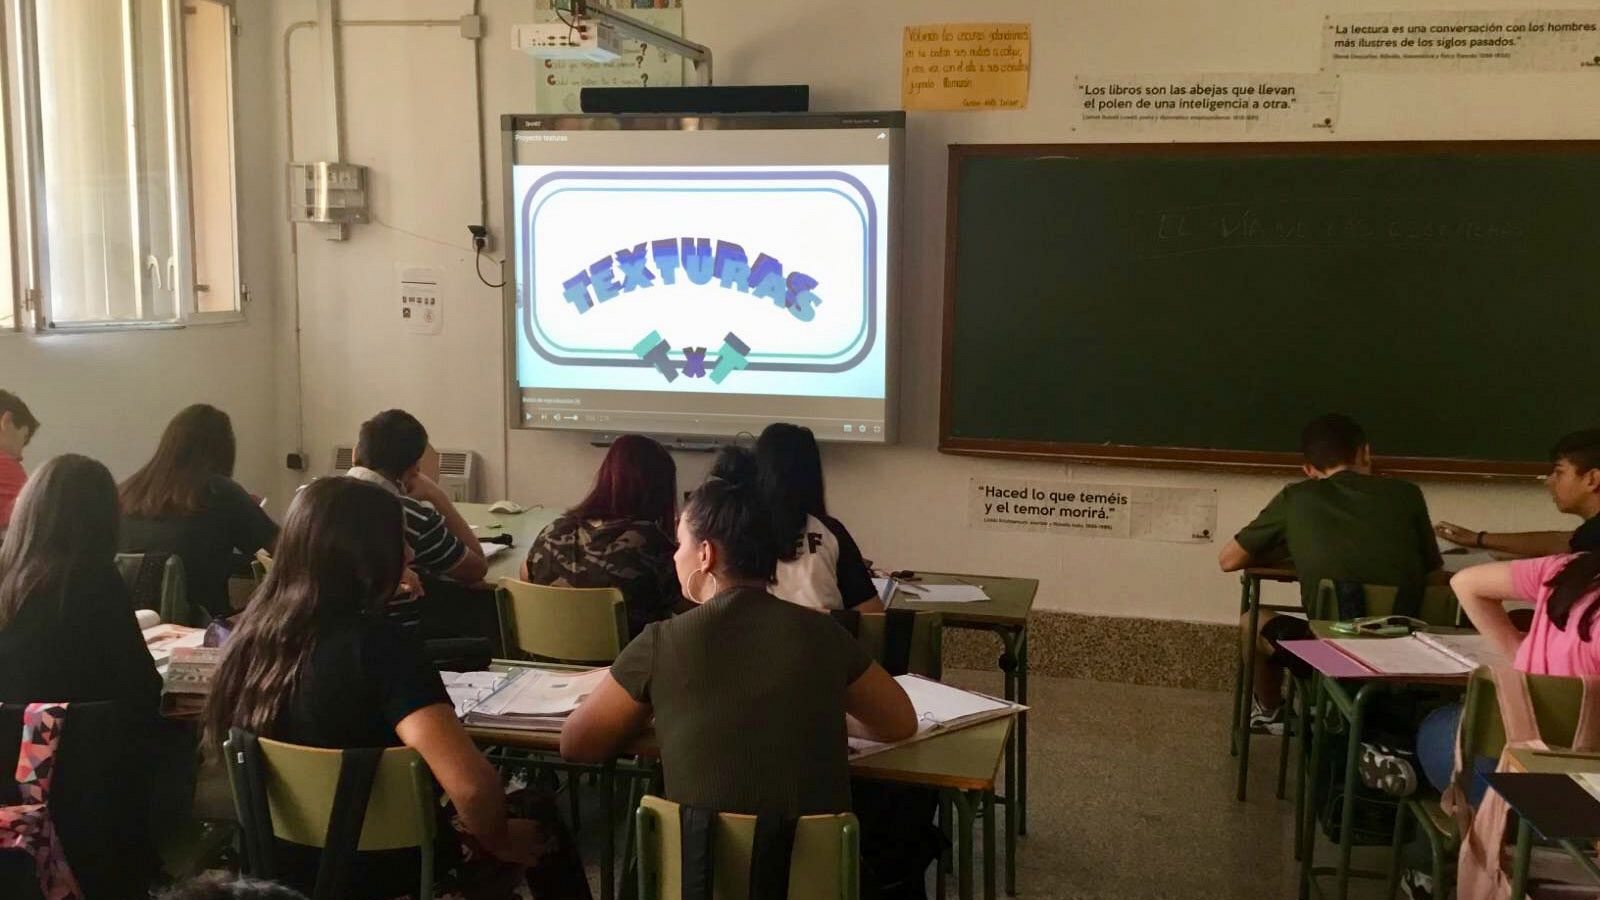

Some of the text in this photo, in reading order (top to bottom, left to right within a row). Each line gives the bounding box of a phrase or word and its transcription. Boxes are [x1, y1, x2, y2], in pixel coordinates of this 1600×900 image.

[1351, 24, 1389, 34] lectura
[1392, 26, 1405, 34] es
[1407, 25, 1427, 33] una
[1430, 22, 1501, 33] conversación
[1506, 24, 1526, 32] con
[1528, 22, 1545, 32] los
[1548, 22, 1597, 32] hombres
[1334, 37, 1355, 48] más
[1359, 37, 1397, 47] ilustres
[1401, 37, 1415, 47] de
[1418, 37, 1433, 47] los
[1437, 37, 1467, 49] siglos
[1109, 84, 1142, 95] libros
[1146, 87, 1166, 95] son
[1170, 84, 1186, 95] las
[1190, 84, 1228, 97] abejas
[1232, 87, 1255, 97] que
[1259, 84, 1295, 95] llevan
[1084, 98, 1096, 109] el
[1099, 99, 1132, 111] polen
[1136, 98, 1151, 109] de
[1155, 101, 1176, 109] una
[1179, 98, 1249, 111] inteligencia
[1252, 101, 1260, 109] a
[562, 237, 823, 322] TEXTURAS
[978, 485, 1128, 505] "Haced lo que teméis
[985, 502, 1116, 519] y el temor morirá."
